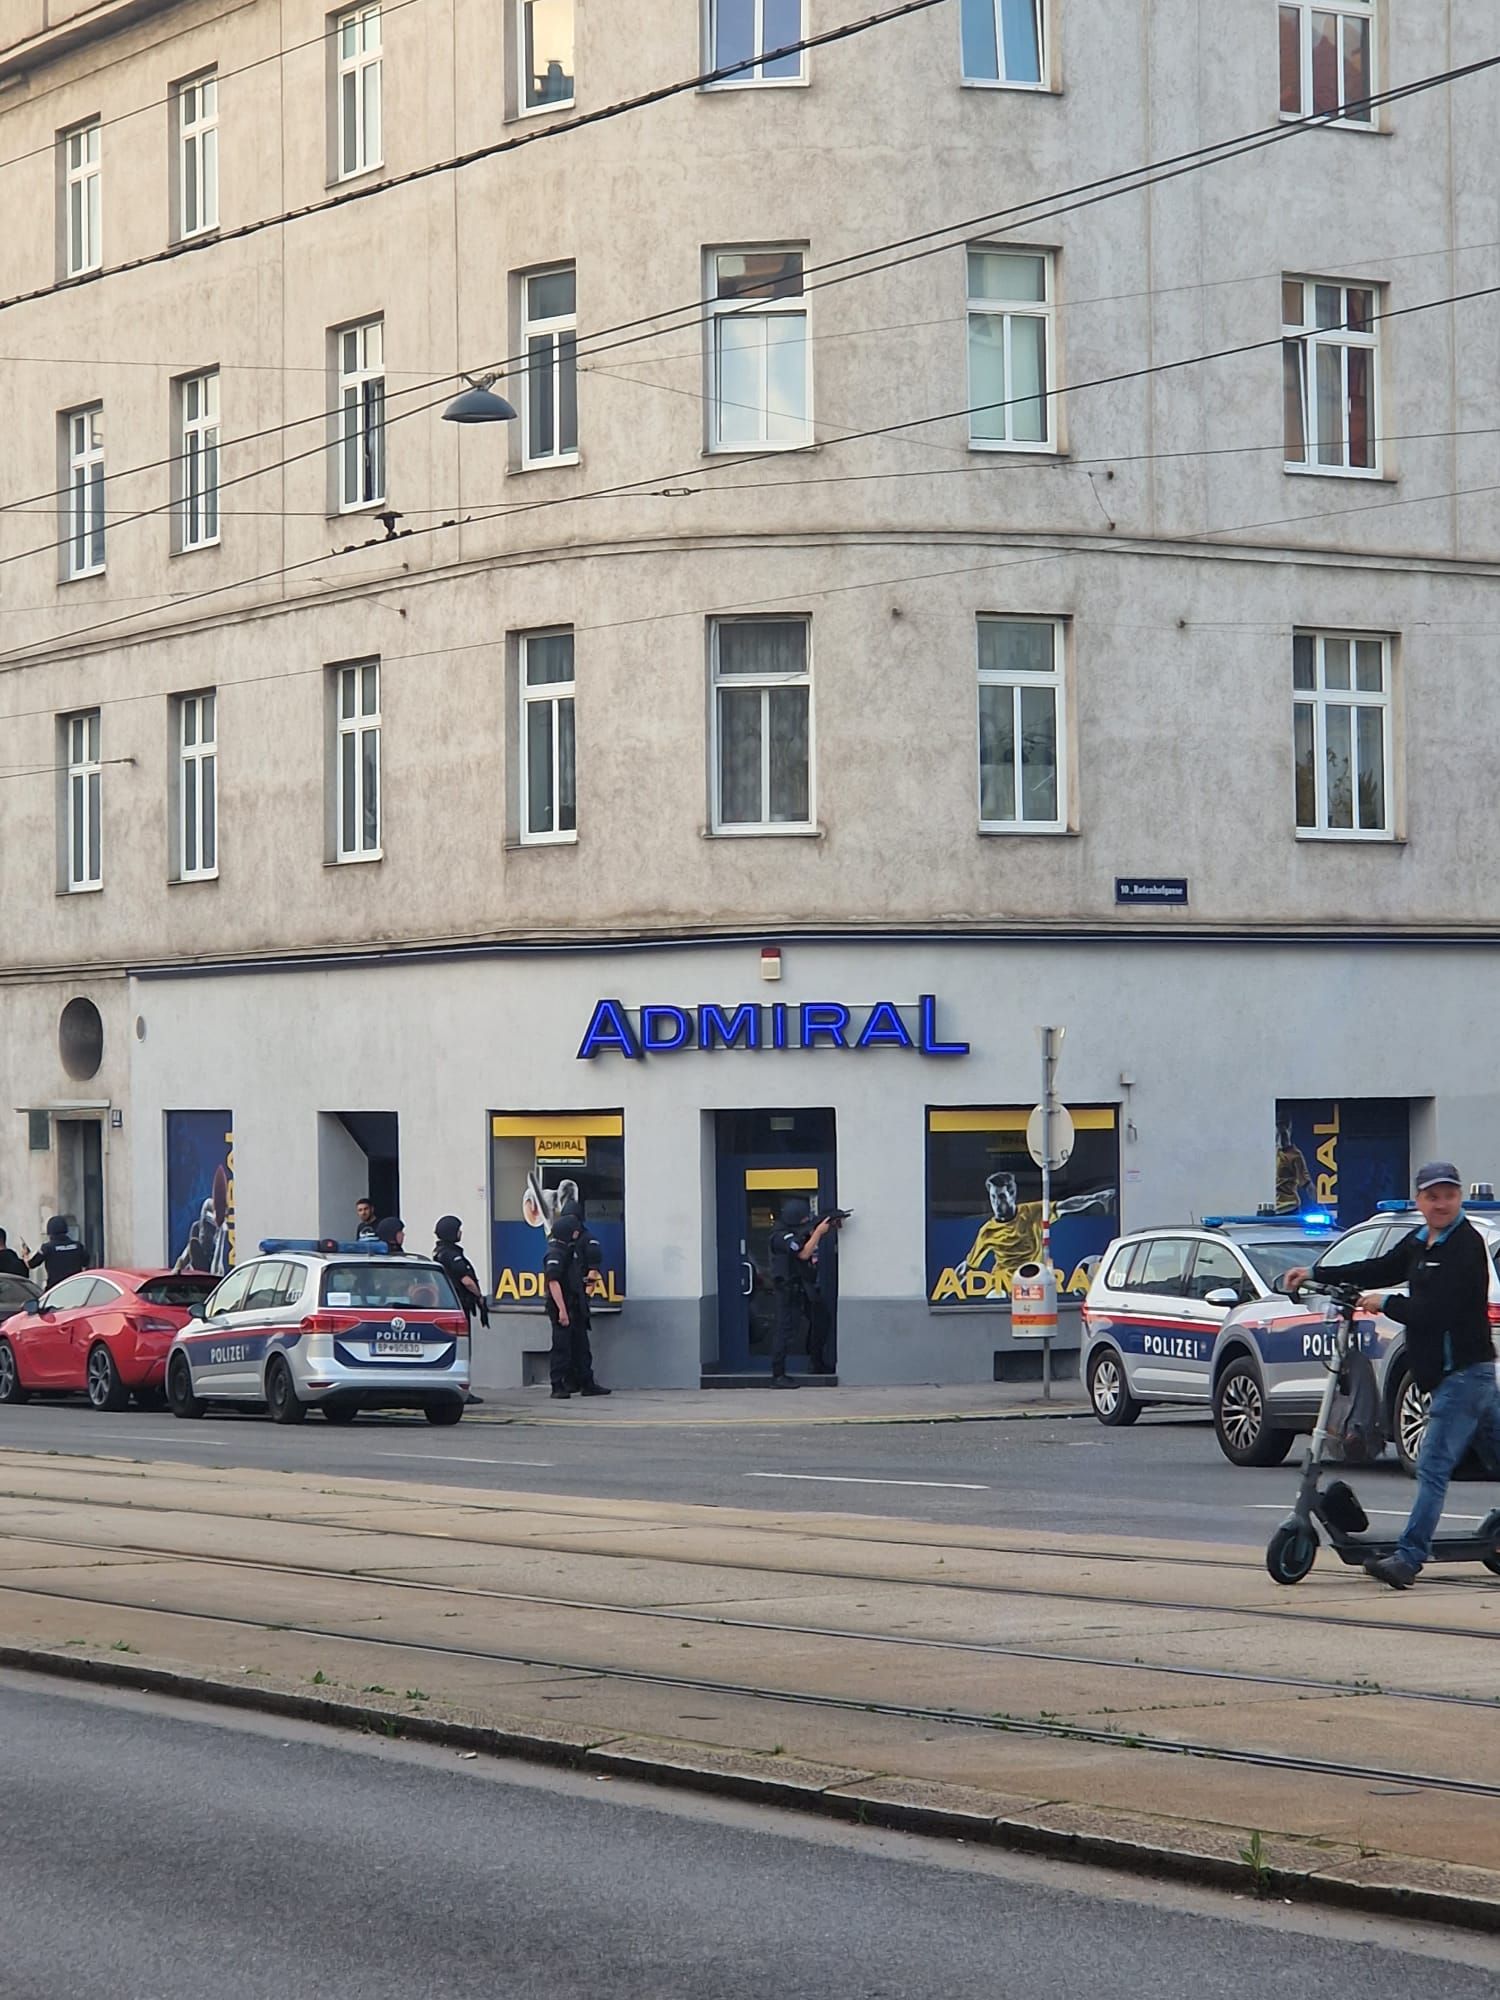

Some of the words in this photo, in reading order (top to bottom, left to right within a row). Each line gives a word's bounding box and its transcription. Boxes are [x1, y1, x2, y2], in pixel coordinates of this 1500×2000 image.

[577, 994, 969, 1059] ADMIRAL
[537, 1139, 584, 1151] ADMIRAL
[1314, 1104, 1339, 1219] RAL
[495, 1268, 624, 1302] ADAL
[376, 1331, 421, 1340] POLIZEI
[1144, 1335, 1198, 1359] POLIZEI
[1303, 1332, 1362, 1356] POLIEI
[210, 1345, 245, 1363] POLIZEI
